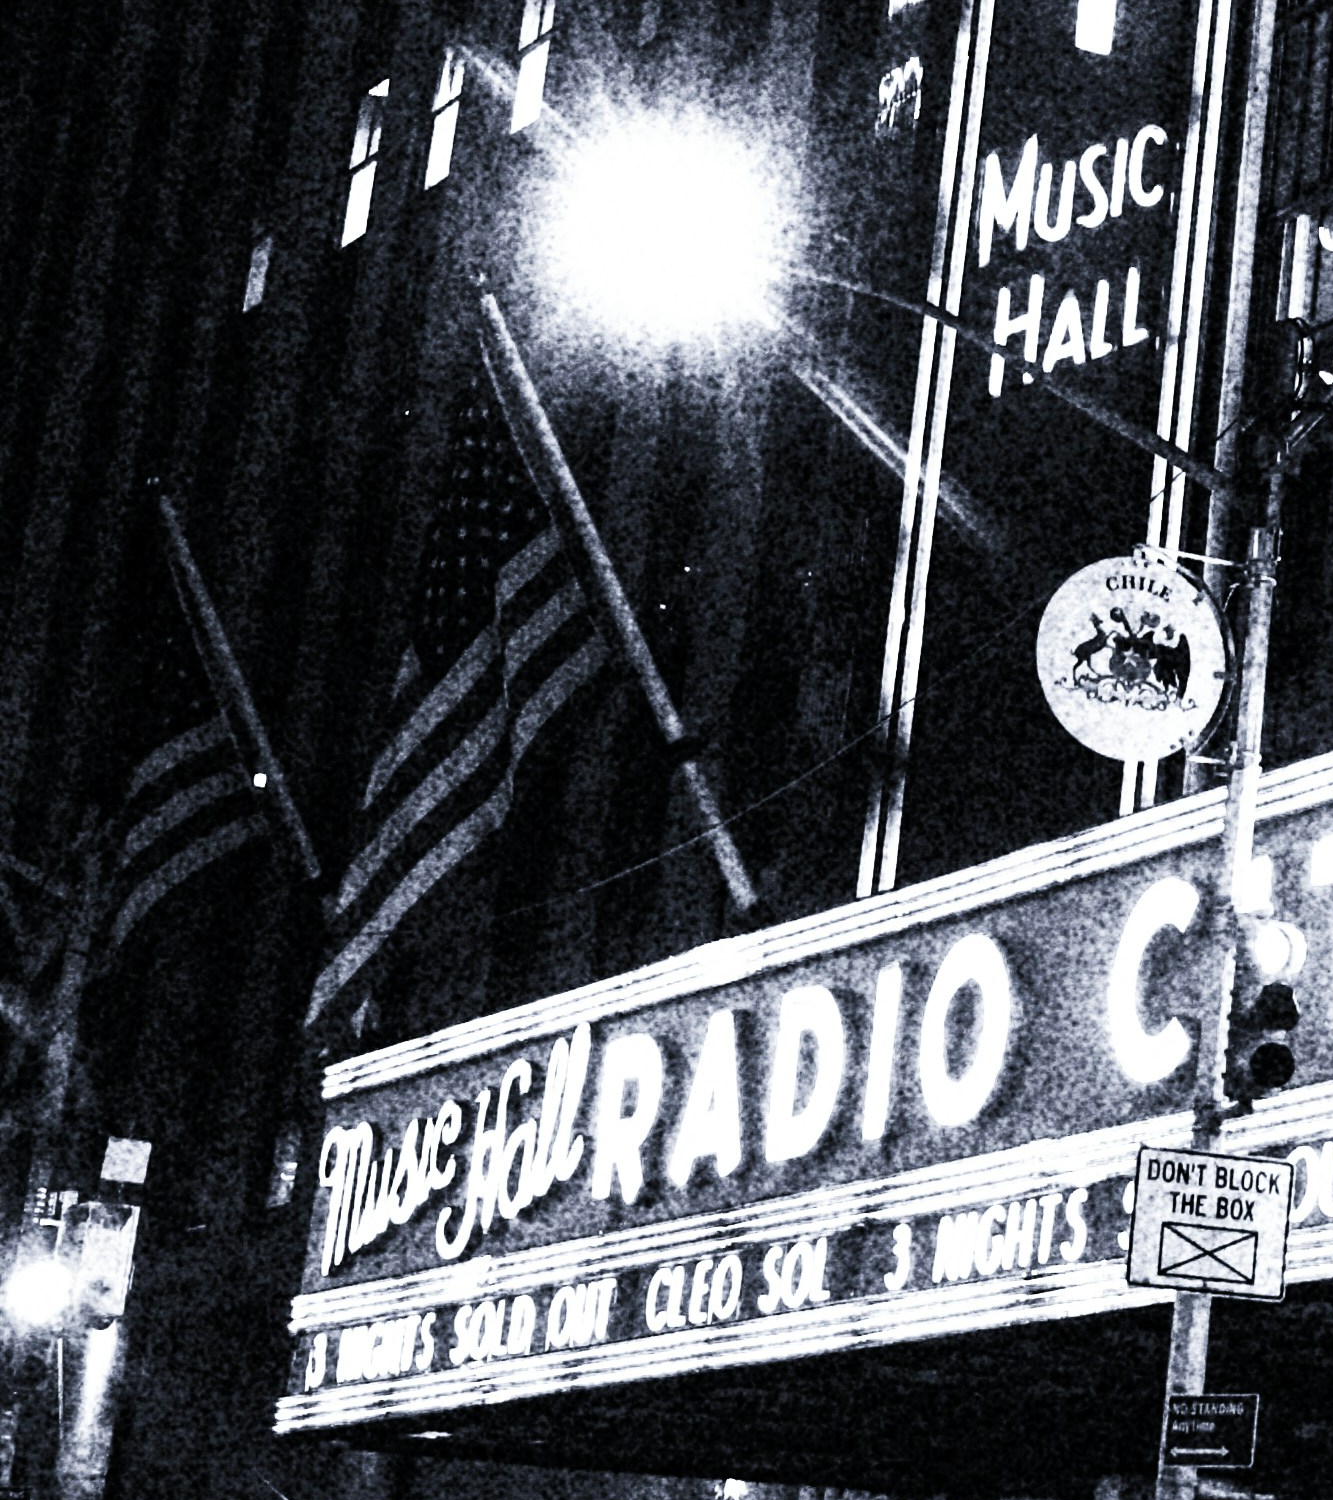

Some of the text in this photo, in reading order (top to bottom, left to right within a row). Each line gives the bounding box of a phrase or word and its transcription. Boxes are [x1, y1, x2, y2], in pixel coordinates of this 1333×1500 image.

[979, 125, 1167, 267] MUSIC
[989, 267, 1148, 398] HALL
[1106, 574, 1172, 602] CHILE
[319, 1100, 462, 1277] Music
[436, 1021, 591, 1259] Hall
[590, 934, 1012, 1202] RADIO
[1147, 1159, 1281, 1196] DON'T BLOCK
[1170, 1190, 1255, 1222] THE BOX
[305, 1332, 328, 1391] 3
[336, 1311, 436, 1384] NIGHTS
[449, 1294, 536, 1366] SOLD
[537, 1278, 617, 1353] OUT
[644, 1235, 741, 1332] CLEO
[760, 1237, 831, 1320] SOL
[884, 1223, 912, 1291] 3
[931, 1188, 1088, 1284] NIGHTS
[1172, 1402, 1244, 1415] NO STANDING
